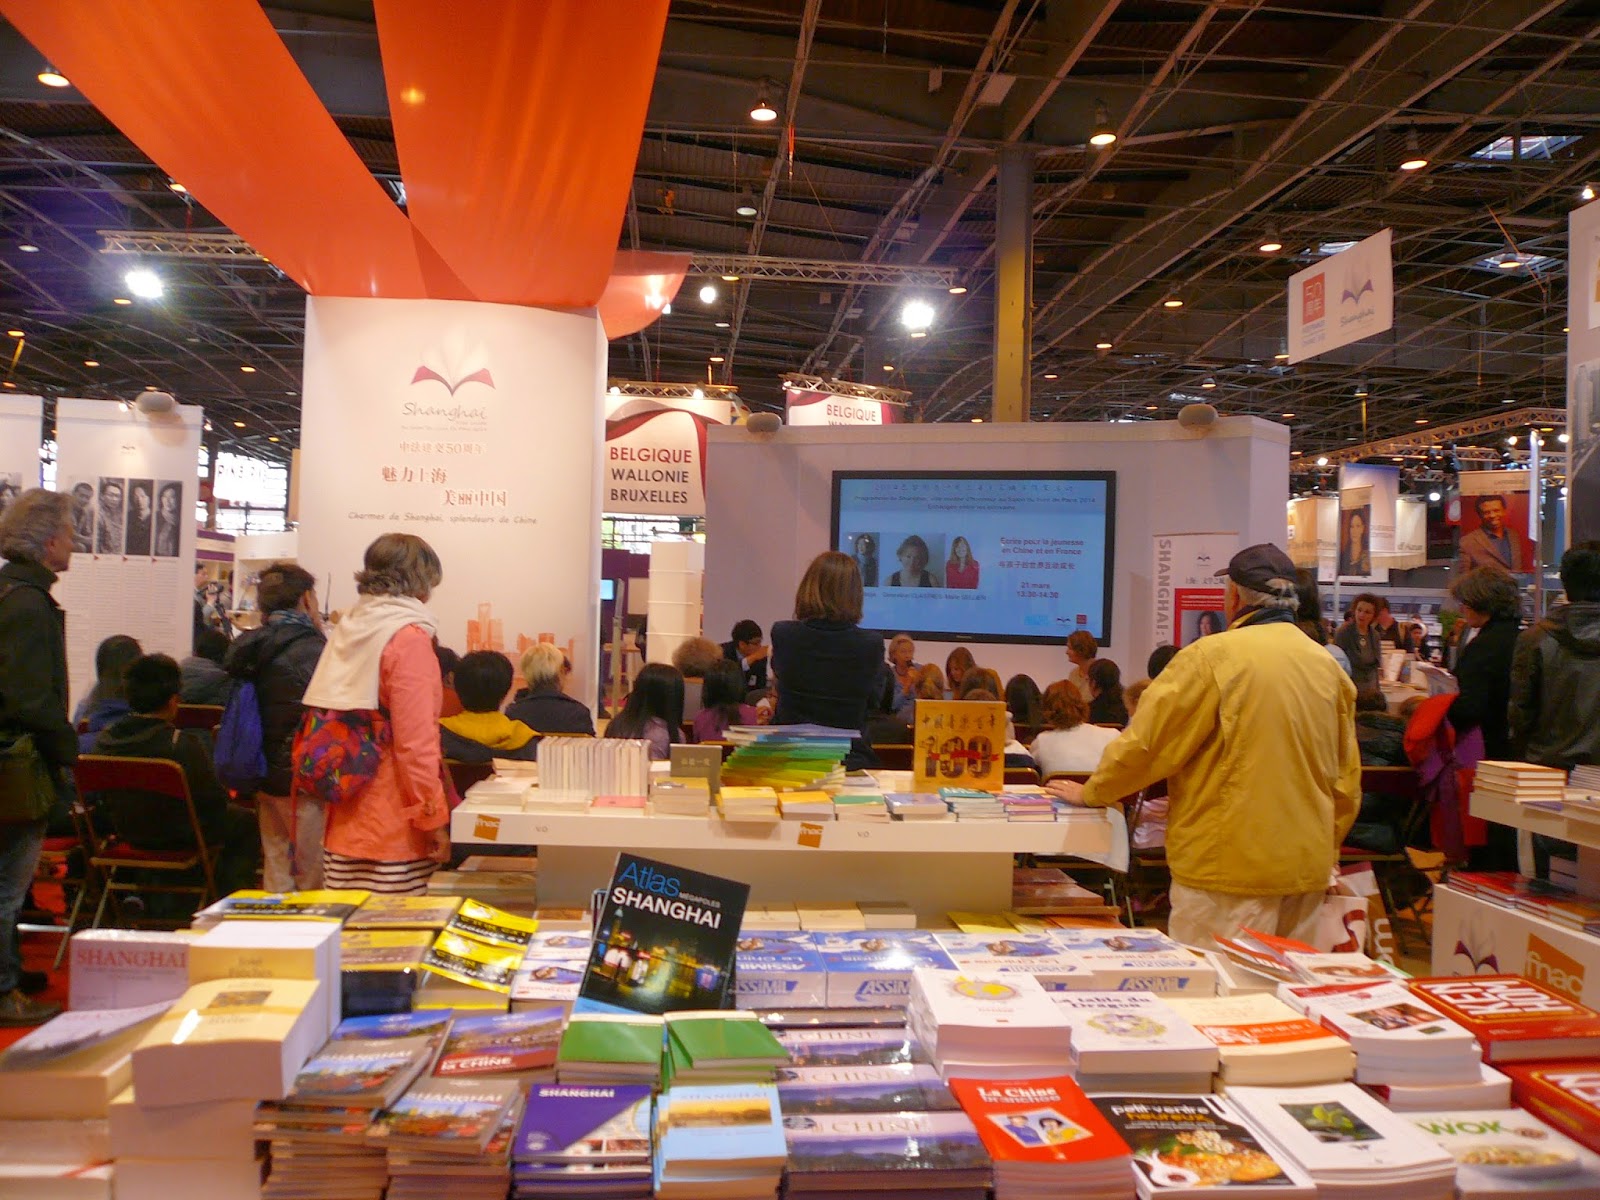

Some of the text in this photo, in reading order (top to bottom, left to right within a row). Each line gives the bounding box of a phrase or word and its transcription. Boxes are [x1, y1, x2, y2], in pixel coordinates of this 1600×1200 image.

[402, 402, 487, 421] Shanghai
[826, 403, 877, 422] BELGIQUE
[609, 446, 693, 464] BELGIQUE
[381, 466, 448, 483] 魅力上海
[611, 467, 690, 483] WALLONIE
[443, 489, 507, 507] 美丽中国
[609, 488, 689, 504] BRUXELLES
[348, 512, 385, 520] Charmes
[389, 512, 400, 521] de
[499, 515, 509, 523] de
[513, 516, 537, 524] Chine
[1012, 546, 1034, 554] Chine
[1055, 547, 1082, 555] France
[1021, 581, 1030, 589] 21
[619, 861, 681, 897] Atlas
[611, 886, 721, 930] SHANGHAI
[77, 950, 186, 968] SHANGHAI
[1525, 950, 1585, 996] fnac
[1421, 980, 1522, 1015] KEN
[1471, 979, 1575, 1013] HOM
[799, 1031, 880, 1040] CHINE
[459, 1056, 512, 1069] CHINE
[538, 1088, 616, 1098] SHANGHAI
[976, 1086, 1058, 1100] La Chine
[1414, 1119, 1501, 1136] WOK
